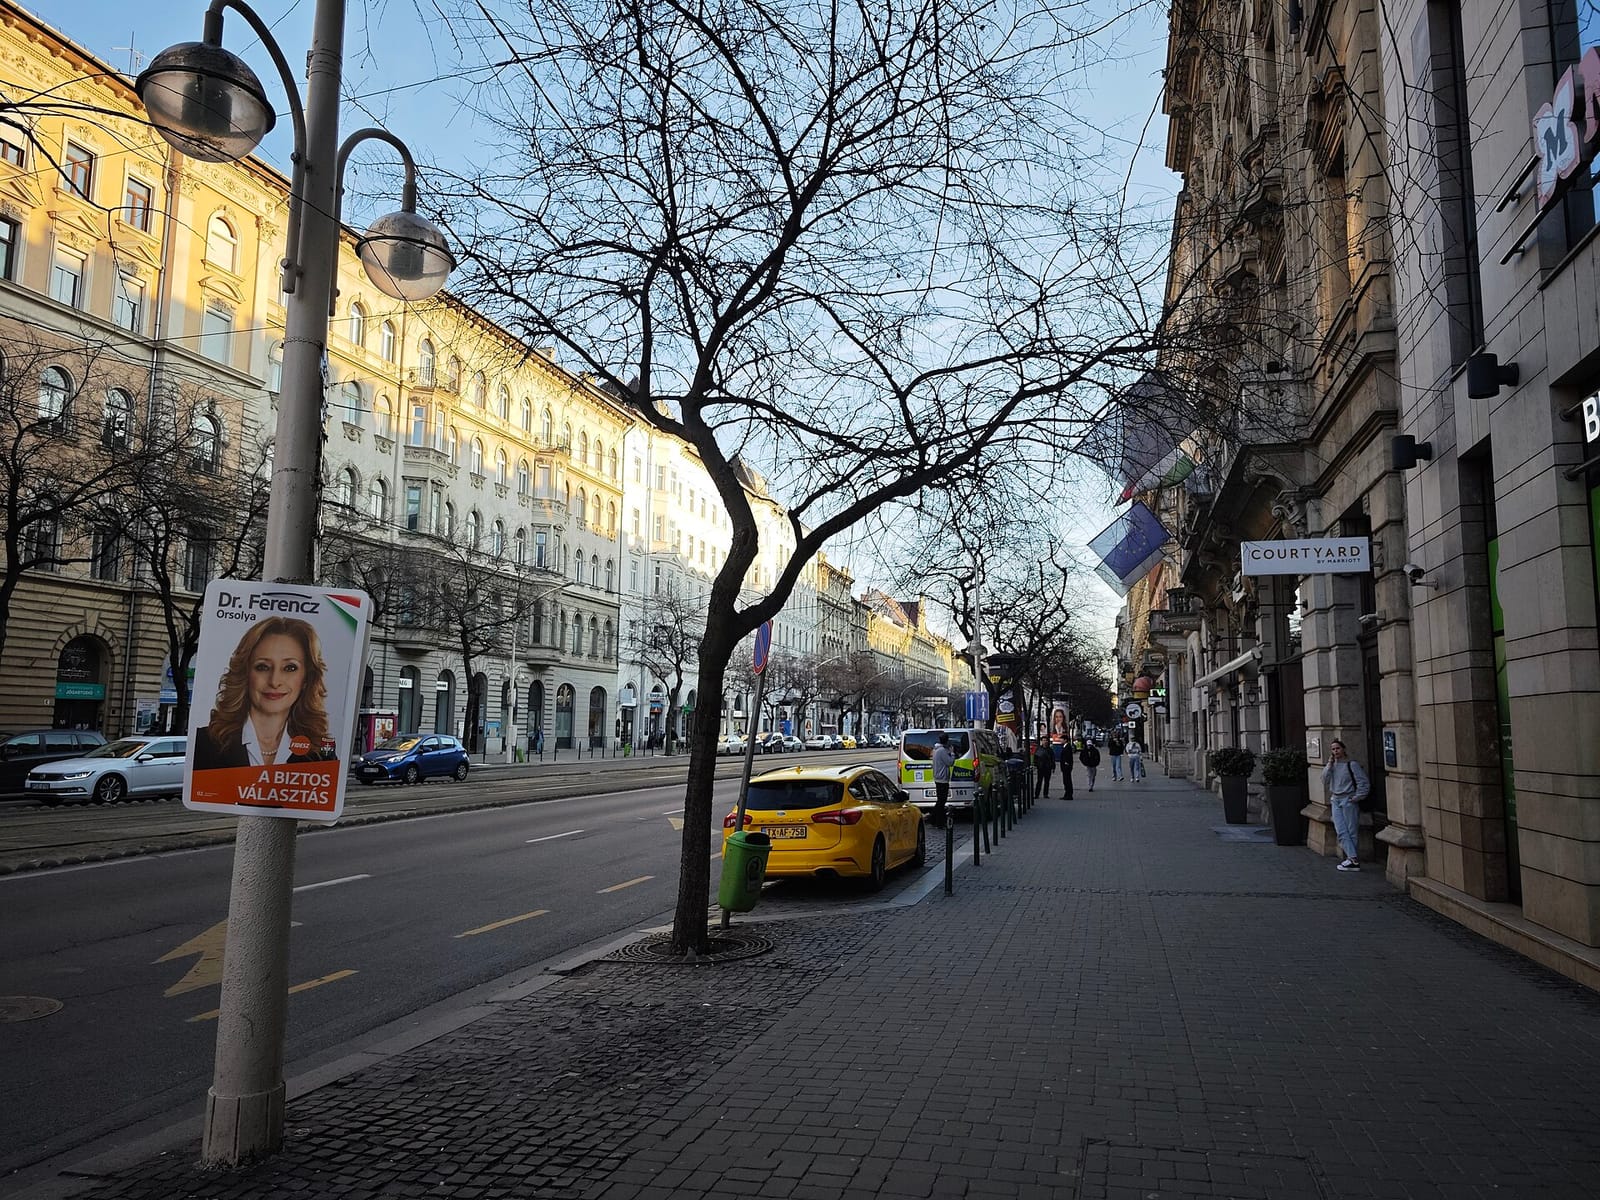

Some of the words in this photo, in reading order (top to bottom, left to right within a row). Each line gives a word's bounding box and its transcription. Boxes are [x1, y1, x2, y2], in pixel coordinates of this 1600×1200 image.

[1544, 108, 1568, 172] M
[1582, 390, 1600, 443] B
[1251, 546, 1361, 560] COURTYARD
[218, 592, 242, 609] Dr.
[248, 594, 321, 614] Ferencz
[216, 609, 257, 622] Orsolya
[258, 770, 270, 783] A
[274, 771, 331, 787] BIZTOS
[238, 783, 329, 804] VÁLASZTÁS
